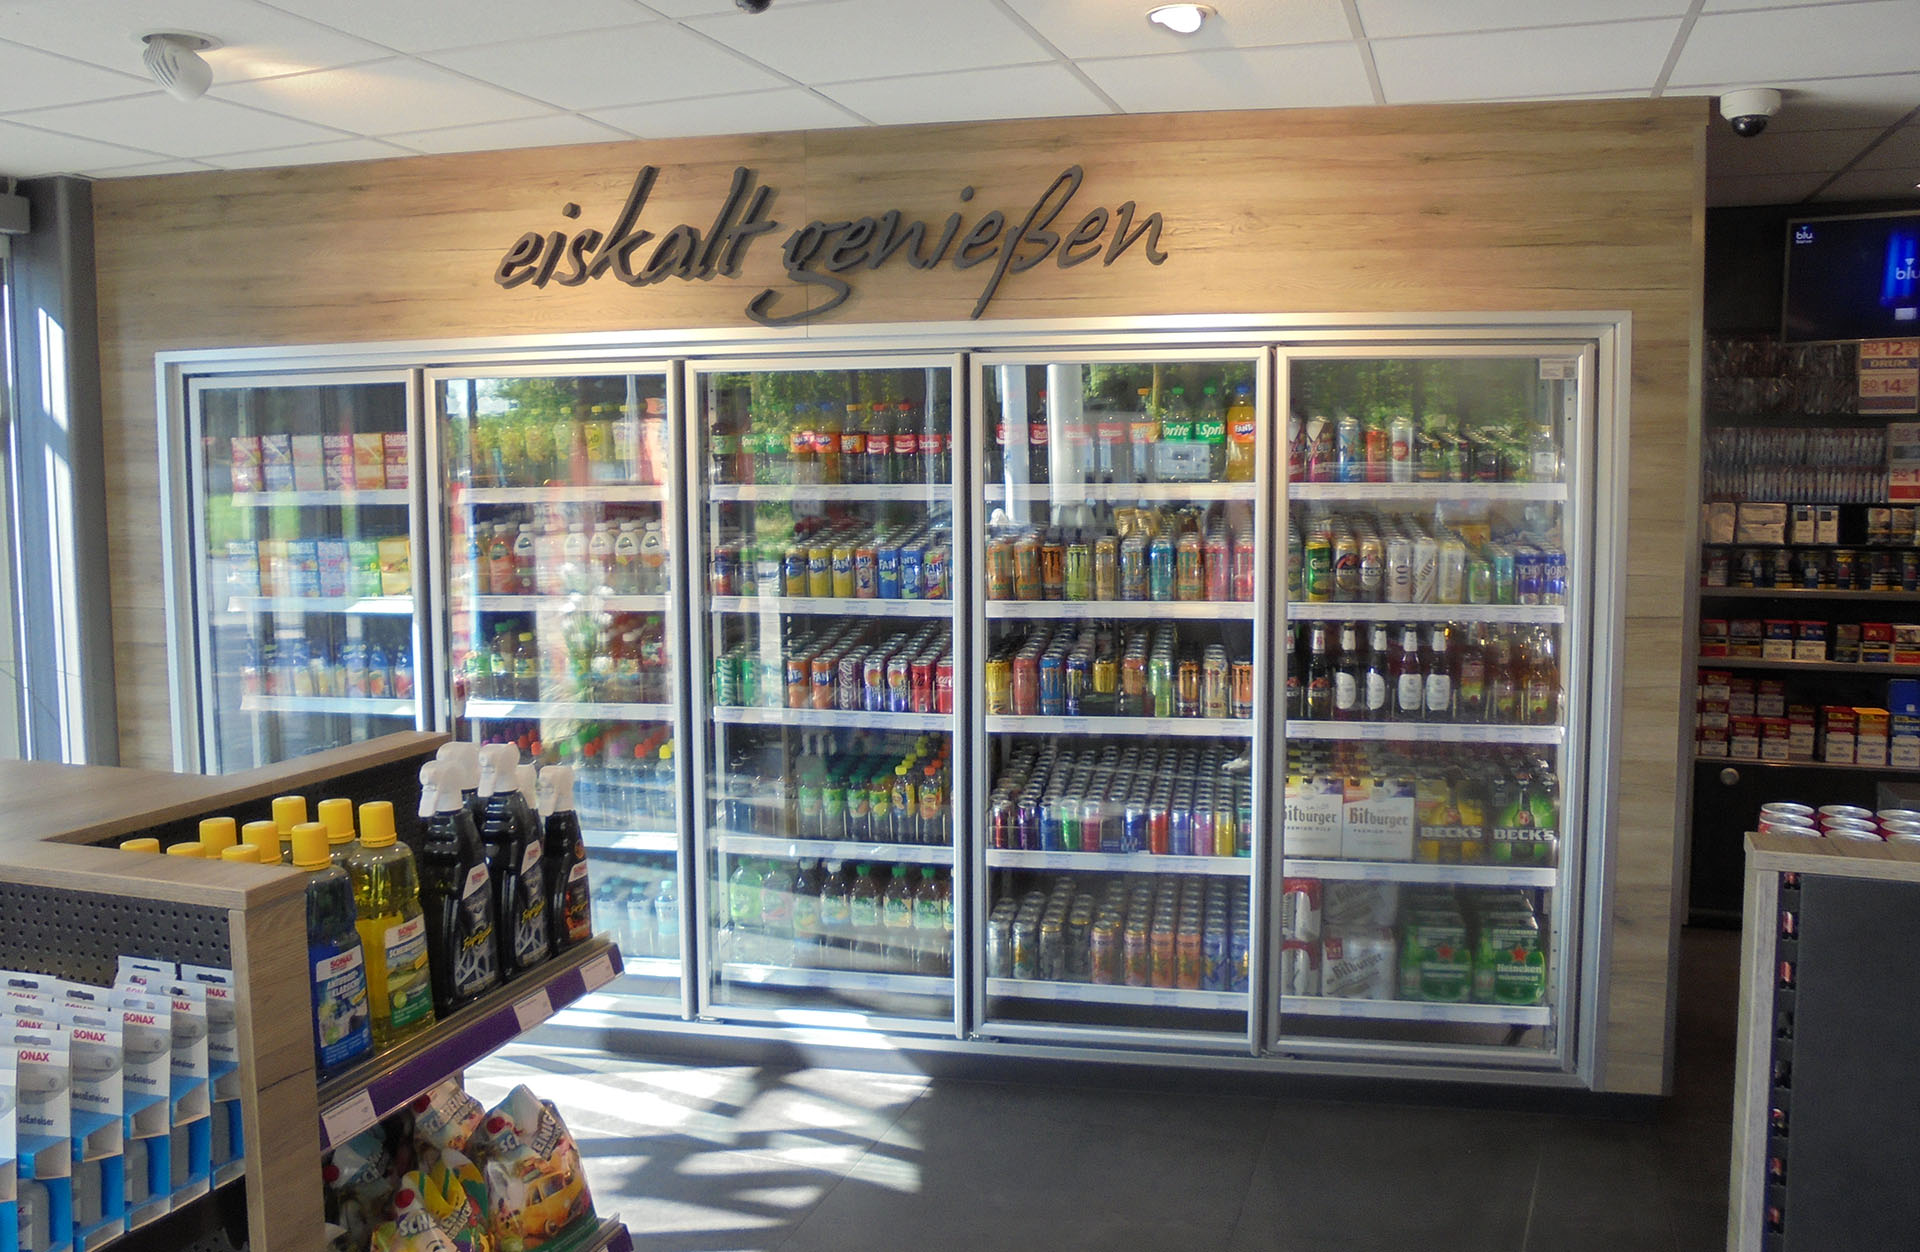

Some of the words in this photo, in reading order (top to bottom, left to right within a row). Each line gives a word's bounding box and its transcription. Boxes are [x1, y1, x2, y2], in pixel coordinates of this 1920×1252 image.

[1795, 231, 1813, 240] blu
[495, 165, 777, 289] eiskalt
[745, 165, 1167, 326] genießen
[1895, 266, 1920, 280] blu
[1881, 342, 1904, 356] 12
[1881, 379, 1901, 393] 14
[1163, 424, 1189, 437] prite
[1348, 807, 1409, 828] Bitburger
[1421, 827, 1482, 838] BECK'S
[1494, 828, 1554, 840] BECK'S
[1497, 963, 1542, 973] Heineken
[172, 1000, 191, 1012] NAX
[123, 1012, 155, 1025] SONAX
[73, 1029, 106, 1042] SONAX
[20, 1050, 50, 1062] ONAX
